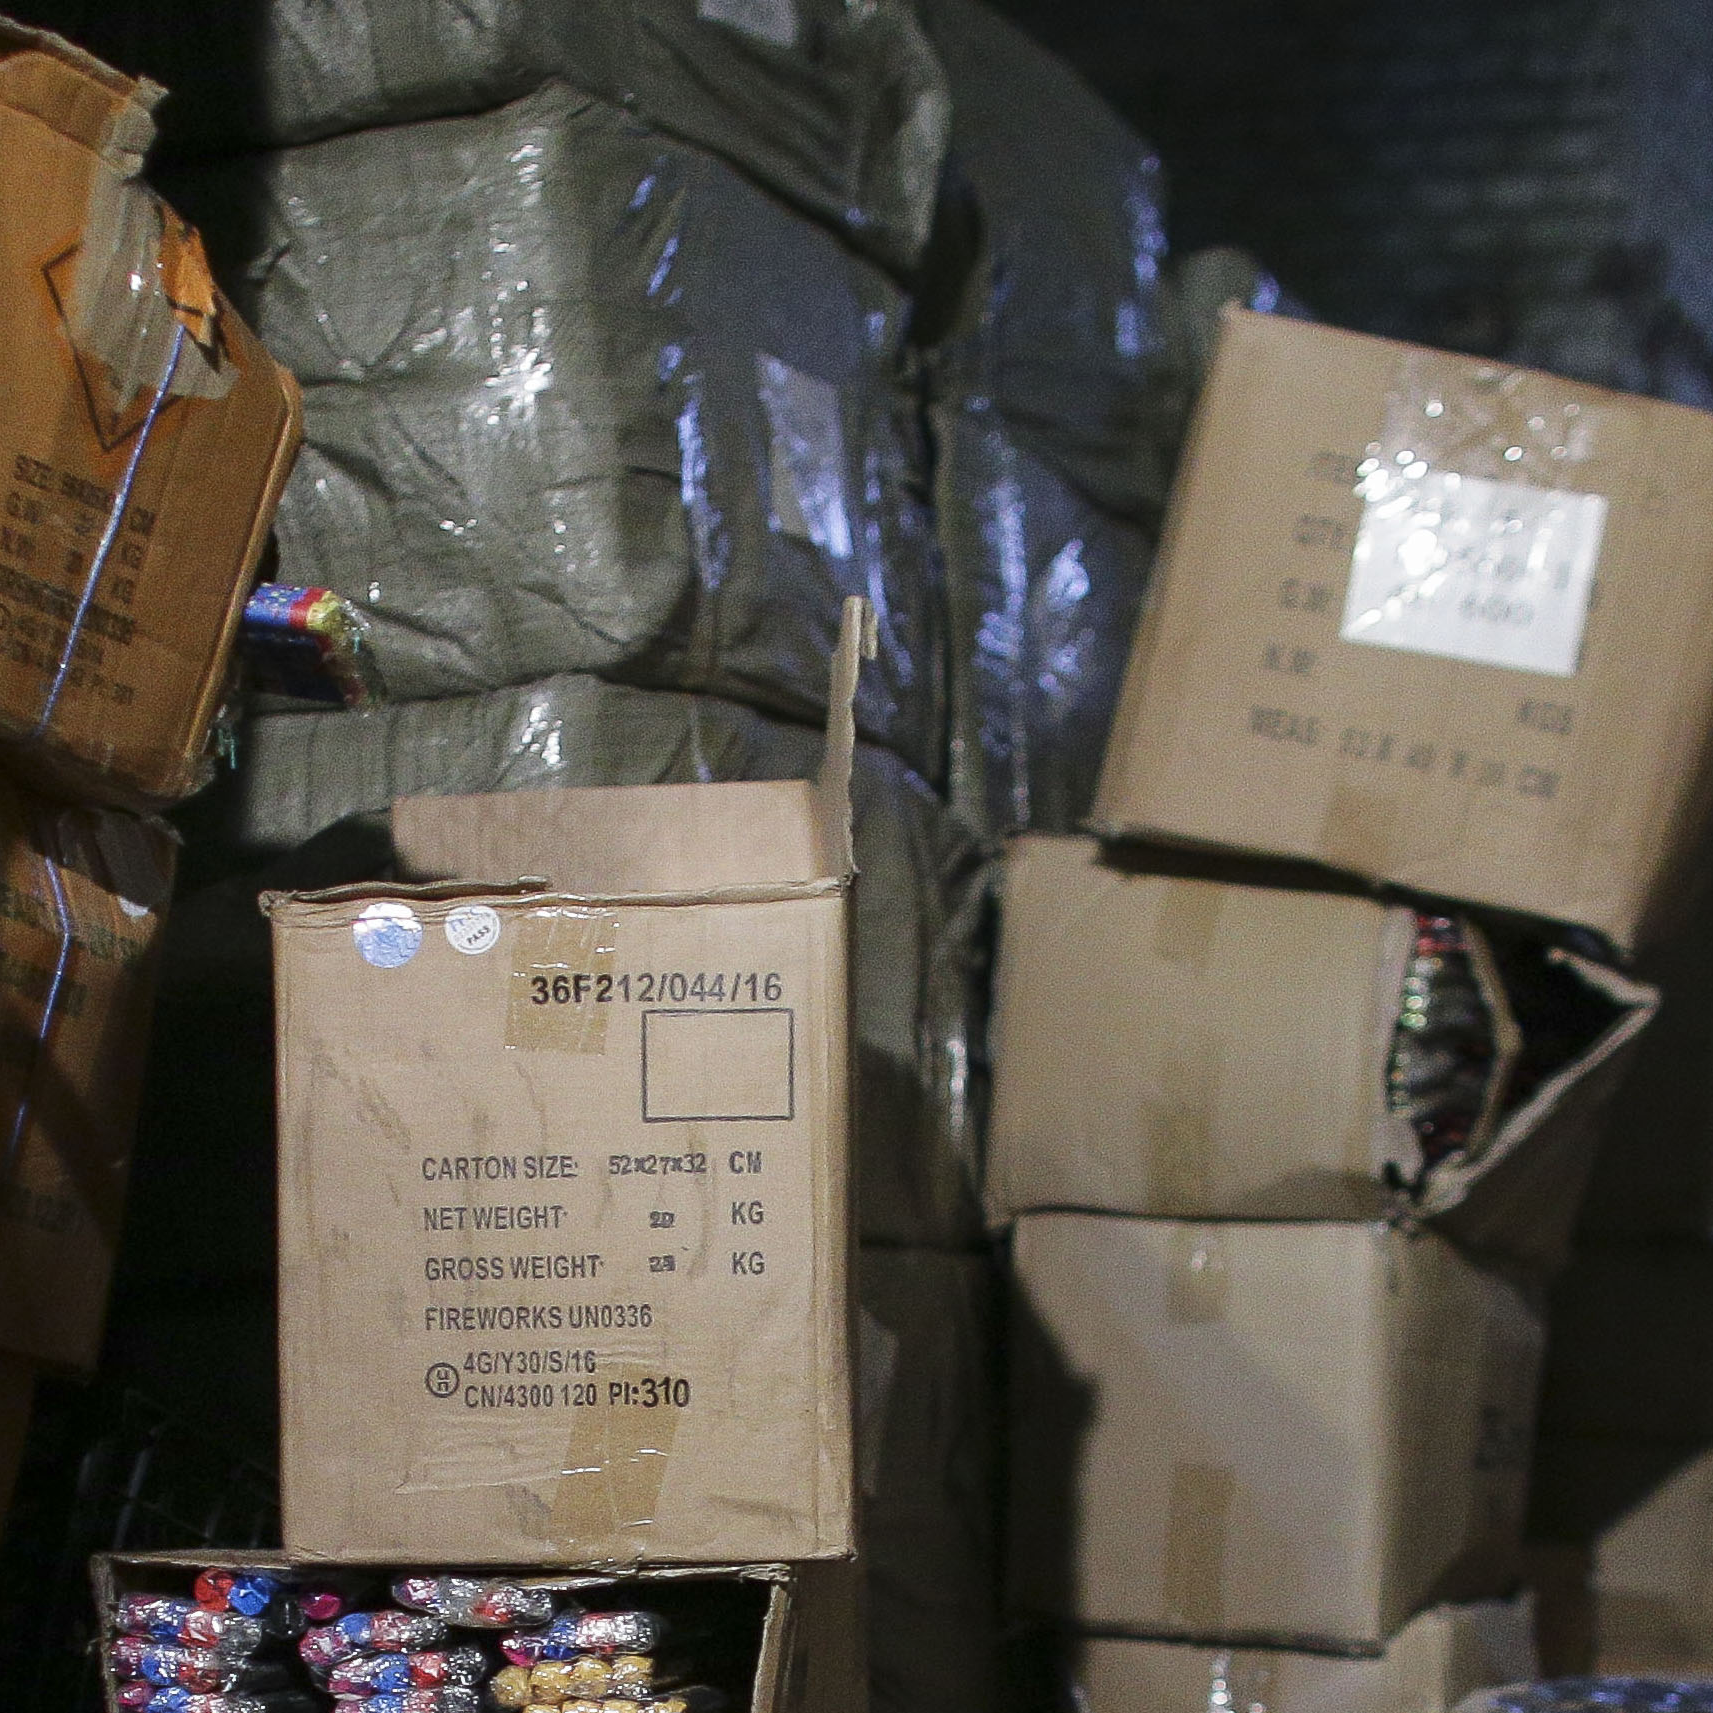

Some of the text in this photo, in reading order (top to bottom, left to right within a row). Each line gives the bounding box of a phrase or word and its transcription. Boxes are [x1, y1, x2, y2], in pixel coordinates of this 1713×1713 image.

[531, 972, 784, 1006] 36F212/044/16
[421, 1157, 517, 1181] CARTON
[729, 1151, 762, 1174] CM
[423, 1207, 467, 1231] NET
[731, 1201, 764, 1225] KG
[424, 1256, 504, 1281] GROSS
[732, 1251, 765, 1276] KG
[425, 1303, 654, 1331] FIREWORKS UN0336
[463, 1350, 596, 1375] 4G/Y30/S/16
[464, 1384, 554, 1409] CN/4300
[559, 1382, 597, 1408] 120
